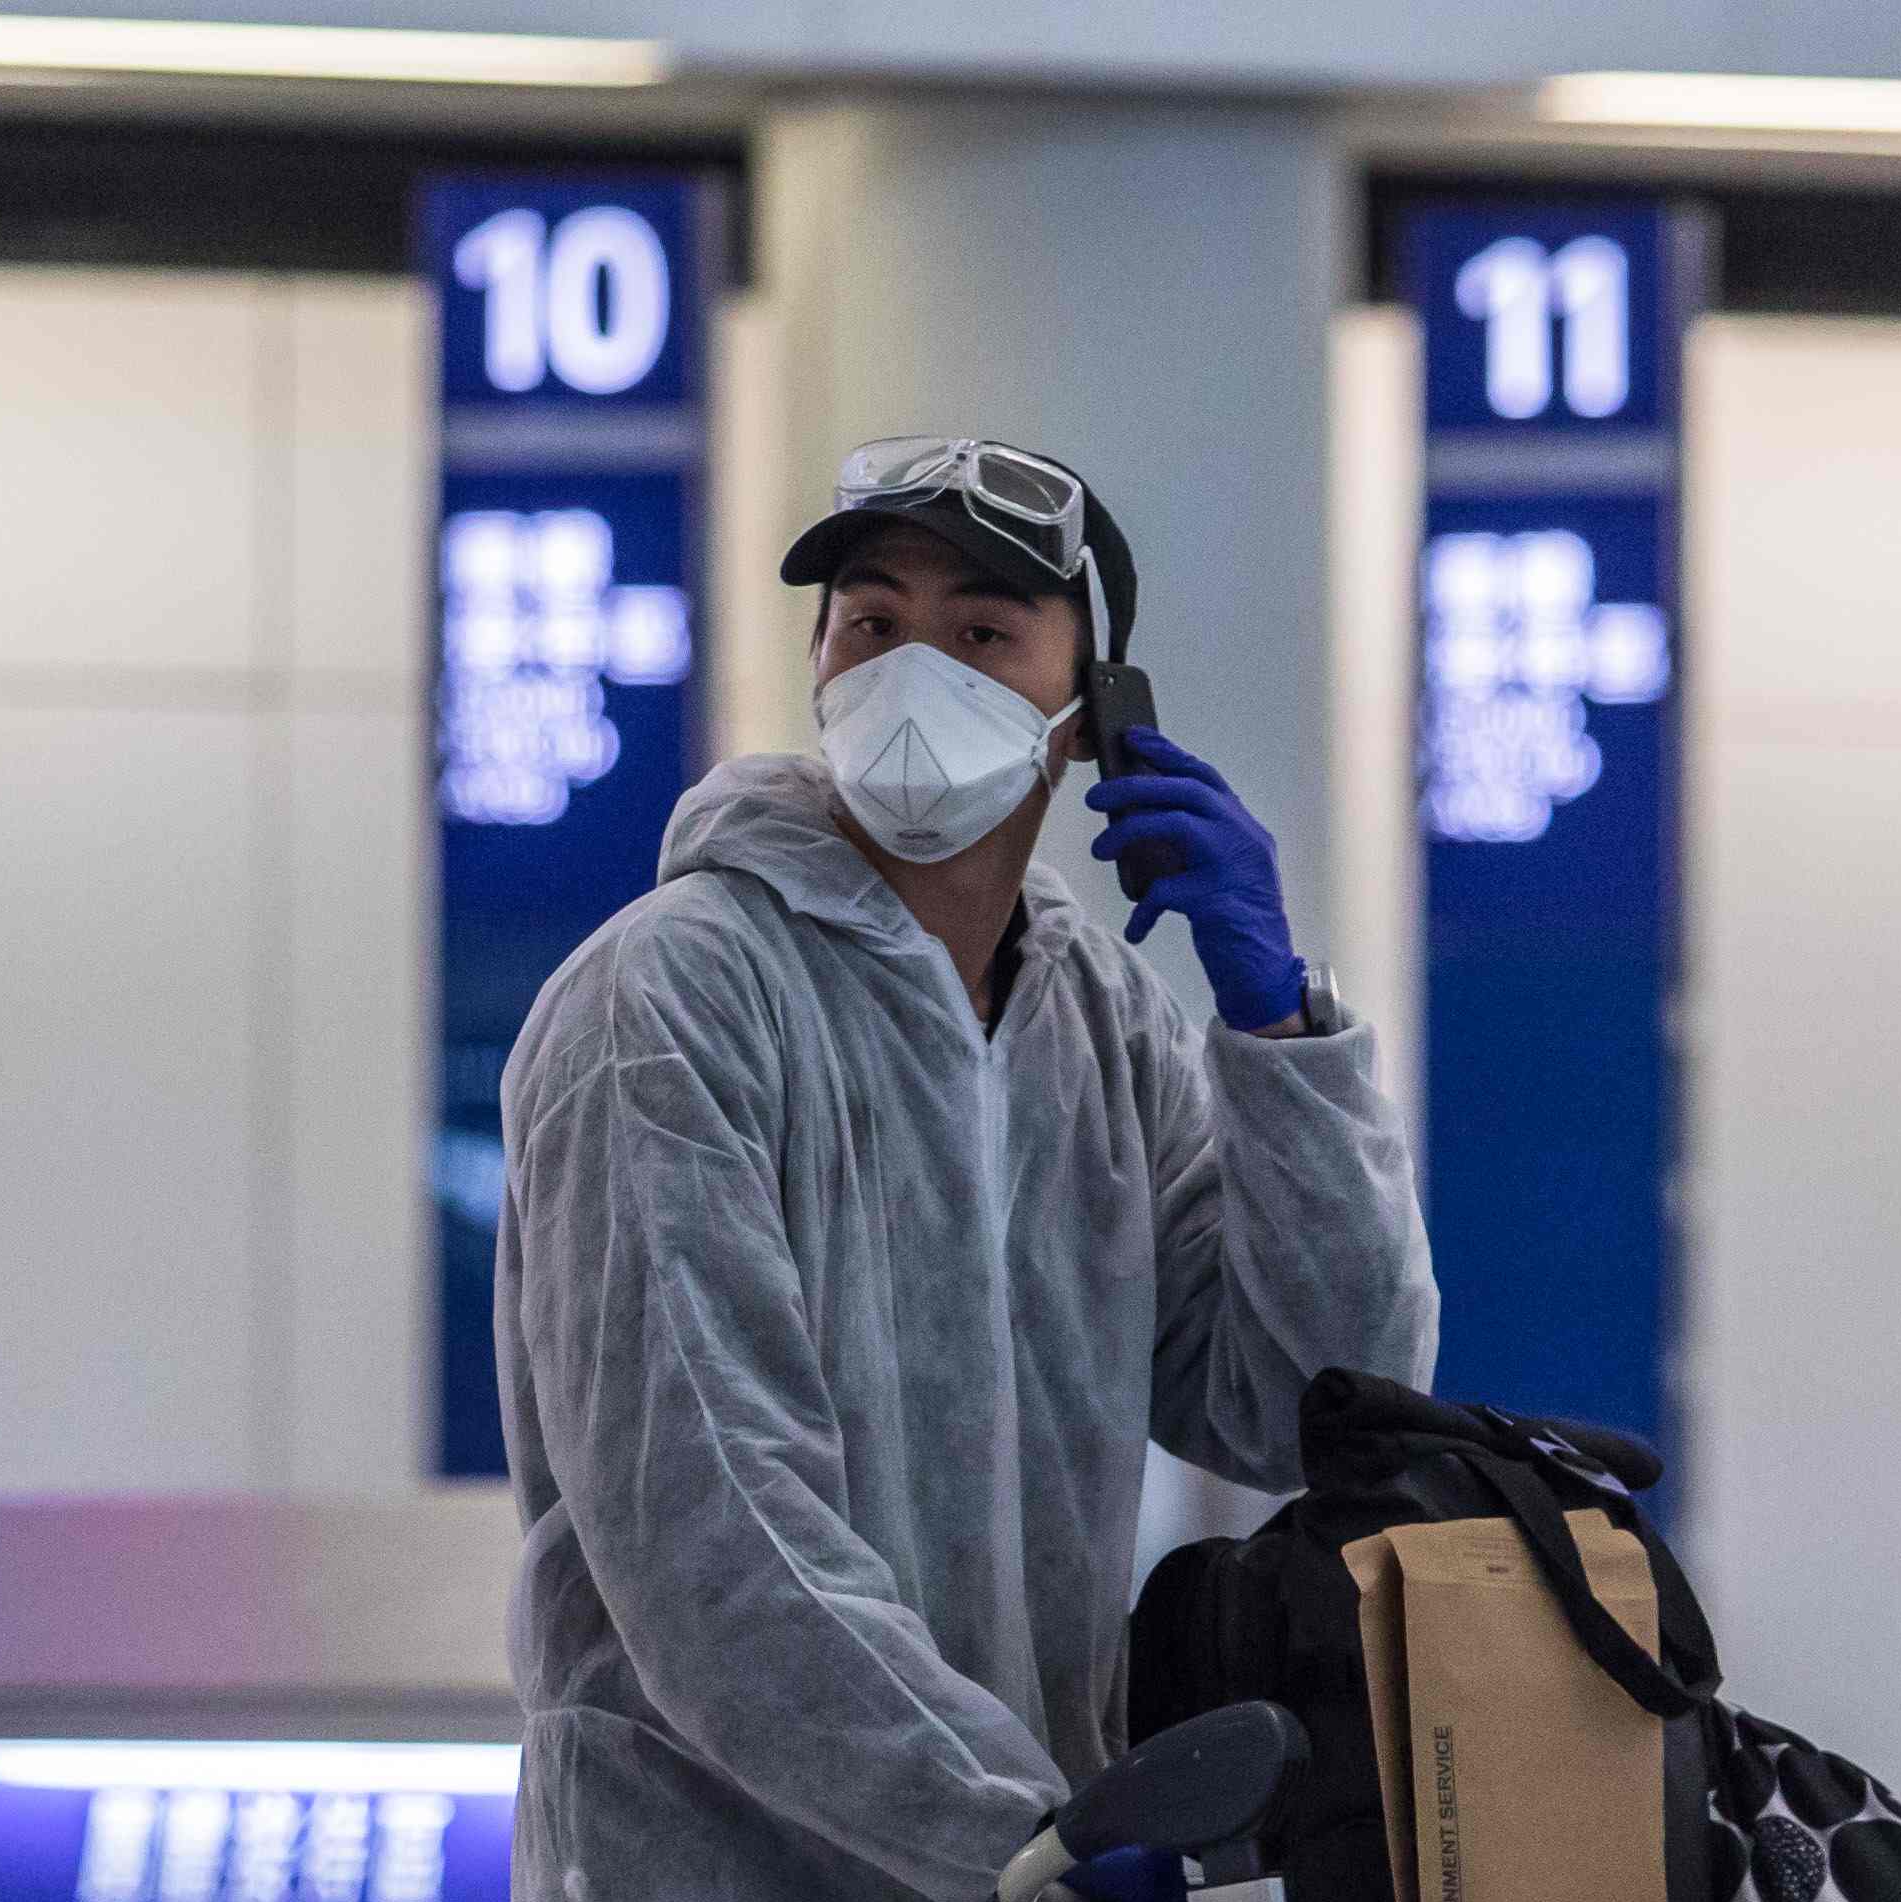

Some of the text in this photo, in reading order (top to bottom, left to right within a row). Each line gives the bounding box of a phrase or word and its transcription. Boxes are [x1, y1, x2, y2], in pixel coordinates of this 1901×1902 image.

[453, 205, 670, 395] 10
[1454, 235, 1630, 419] 11
[1434, 1726, 1457, 1819] SERVICE
